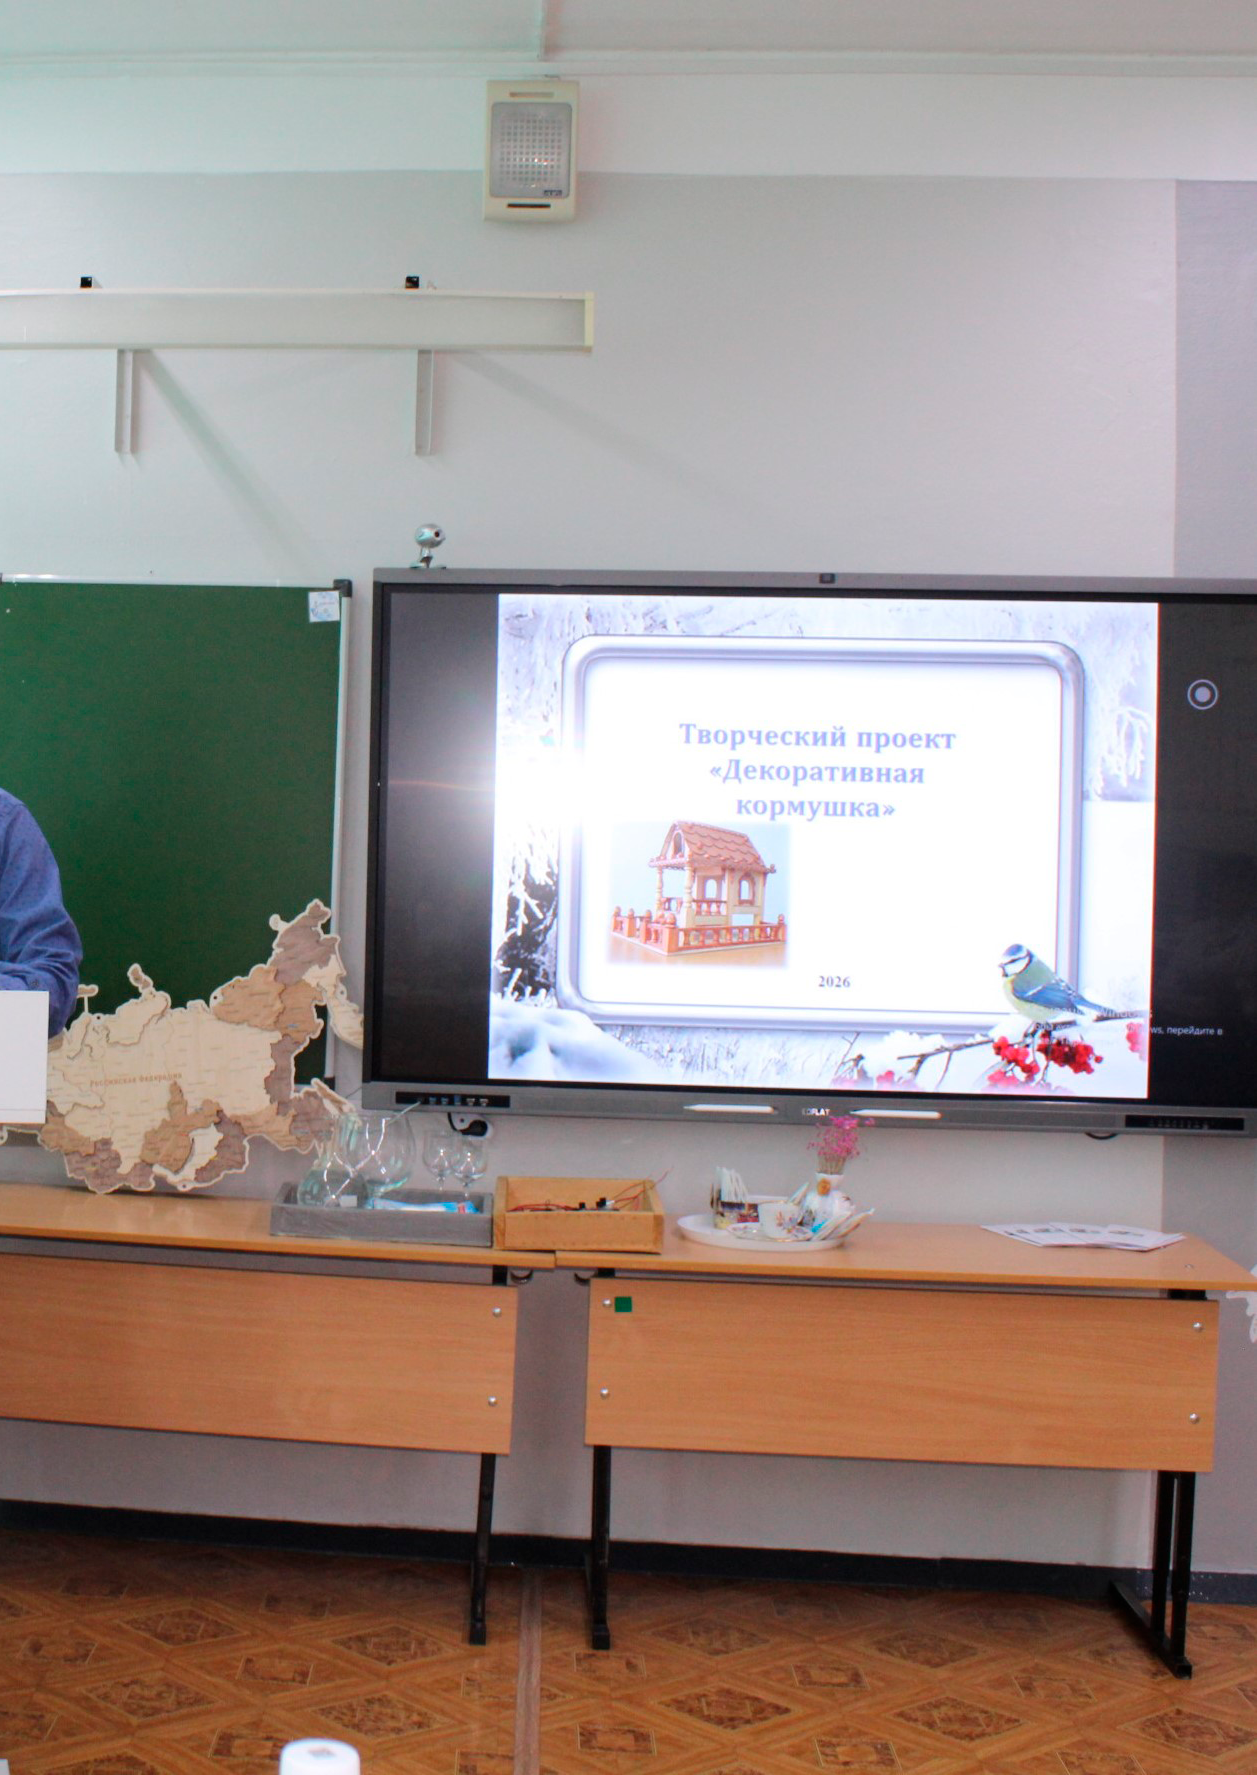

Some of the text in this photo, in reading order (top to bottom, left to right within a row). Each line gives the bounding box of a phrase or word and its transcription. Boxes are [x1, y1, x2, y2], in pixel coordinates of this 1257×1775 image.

[679, 723, 957, 753] Творческий проект
[710, 758, 925, 787] «Декоративная
[736, 797, 896, 822] кормушка»
[818, 975, 851, 988] 2026
[1166, 1025, 1215, 1037] перейдите
